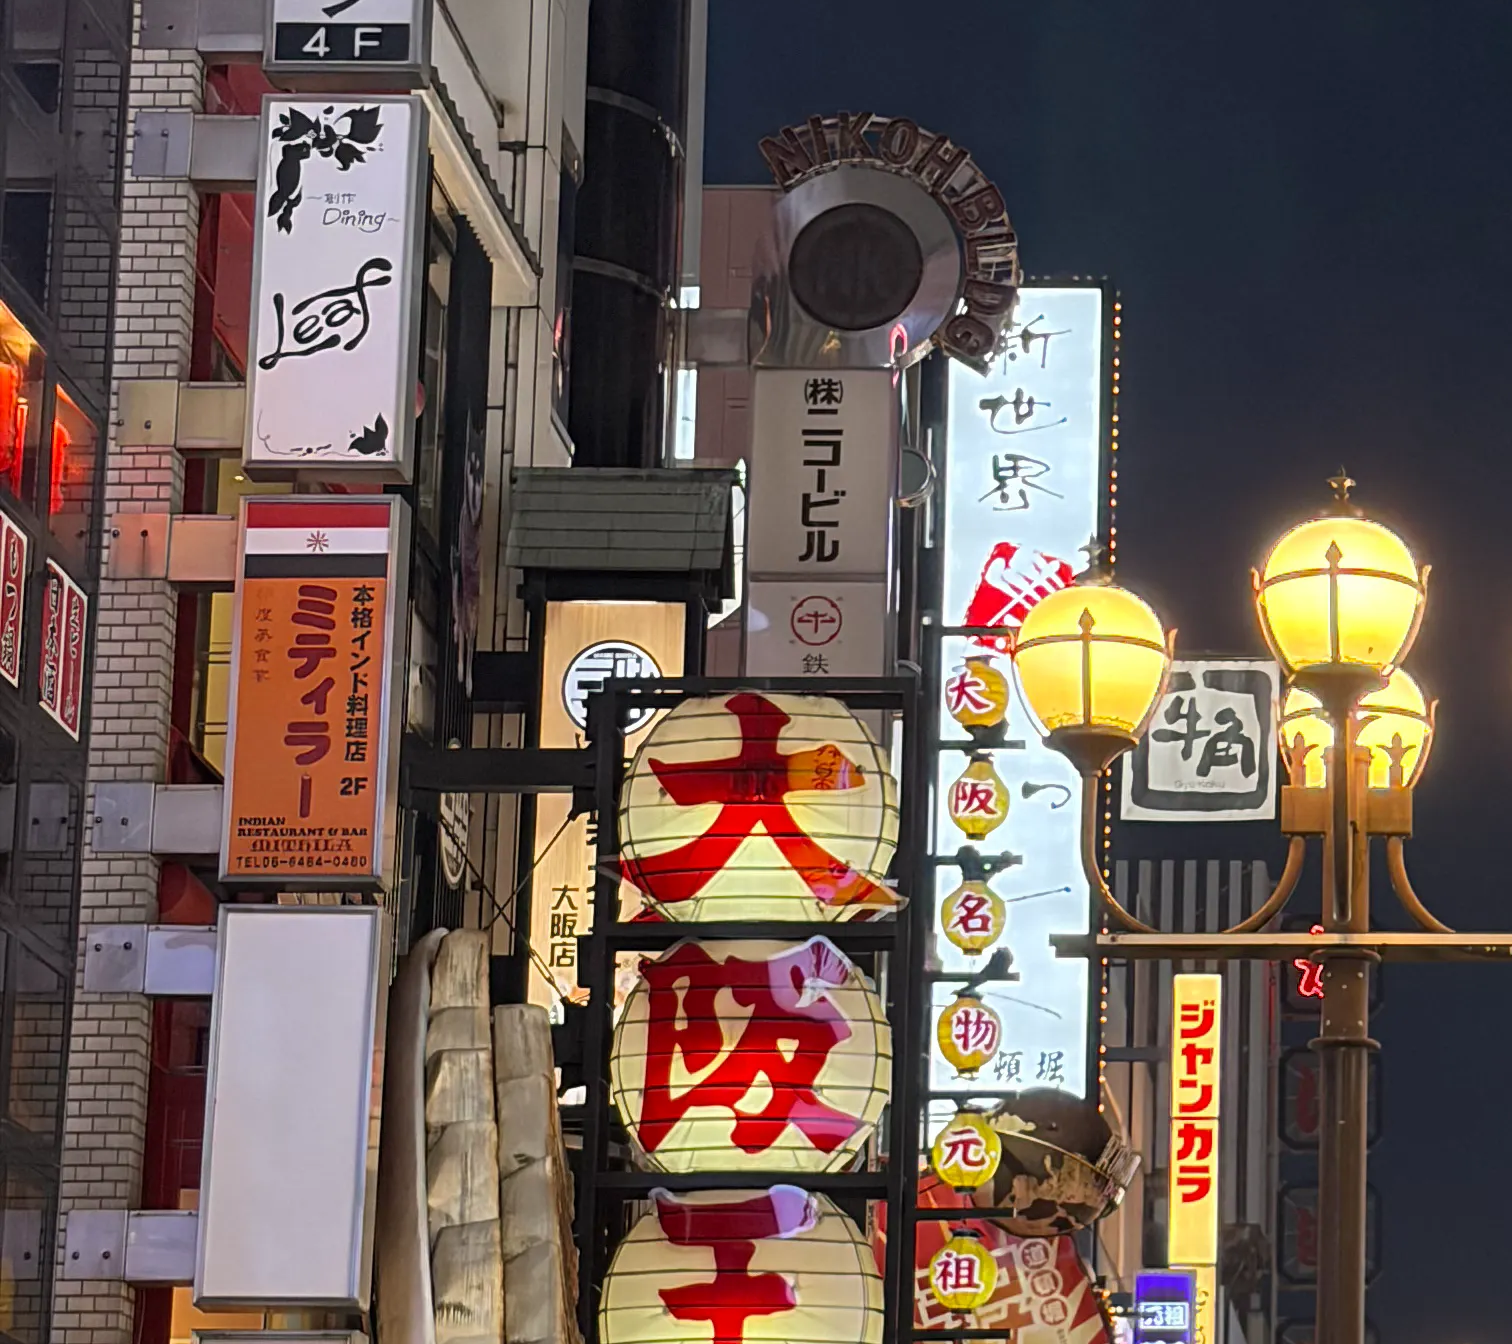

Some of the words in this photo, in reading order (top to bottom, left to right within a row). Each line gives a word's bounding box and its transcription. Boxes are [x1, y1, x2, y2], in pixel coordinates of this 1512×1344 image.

[759, 110, 970, 193] NIKOH
[322, 207, 387, 234] Dining
[259, 257, 393, 370] Leaf
[284, 584, 338, 818] ミティラー
[344, 585, 375, 762] 本格インド料理店
[1151, 696, 1257, 777] 牛角
[340, 776, 368, 796] 2F
[237, 827, 325, 838] RESTAURANT
[549, 884, 579, 968] 大阪店
[1176, 999, 1215, 1202] ジャンカラ
